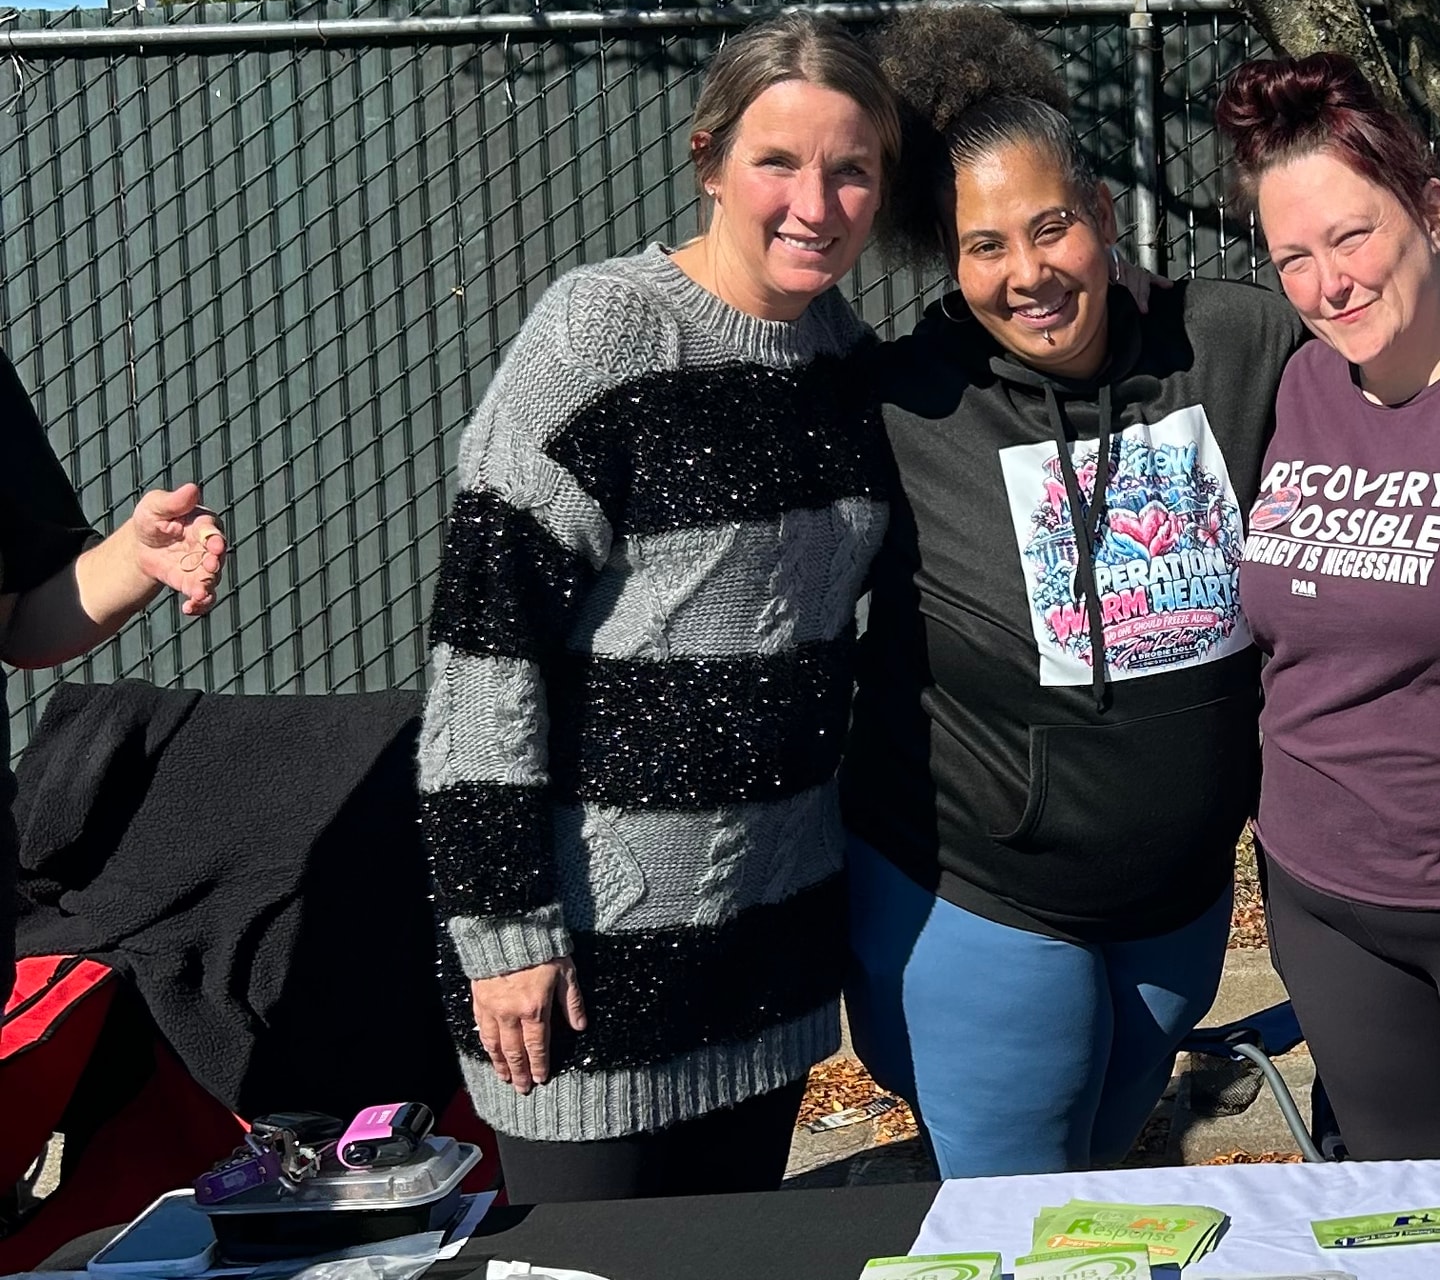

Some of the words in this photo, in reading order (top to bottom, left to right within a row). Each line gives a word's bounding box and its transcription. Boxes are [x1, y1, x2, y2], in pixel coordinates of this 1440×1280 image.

[1298, 545, 1322, 572] IS
[1321, 548, 1435, 587] NECESSARY
[1291, 579, 1317, 595] PAR
[1132, 619, 1163, 635] SHOULD
[1163, 615, 1190, 627] FREEZE
[1191, 613, 1214, 624] ALONE
